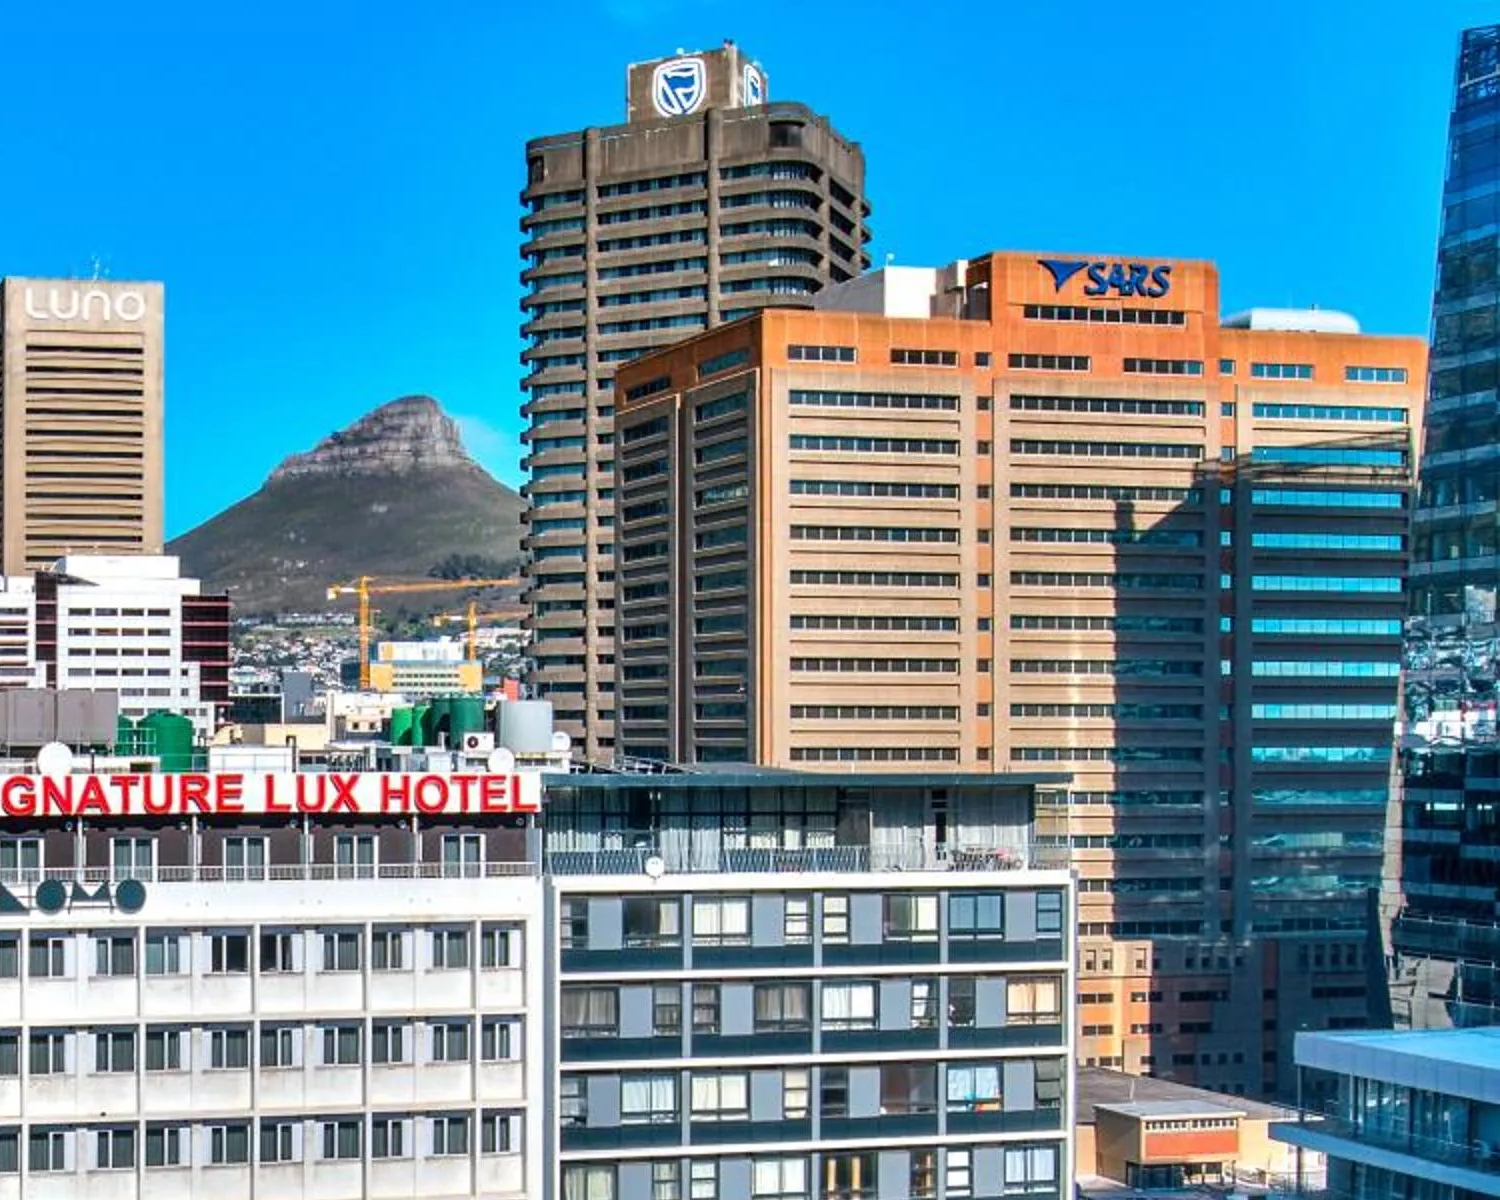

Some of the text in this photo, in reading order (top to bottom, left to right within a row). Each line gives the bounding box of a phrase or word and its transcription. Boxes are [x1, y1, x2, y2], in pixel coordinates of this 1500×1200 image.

[1084, 261, 1172, 297] SARS
[264, 773, 361, 814] LUX
[380, 773, 538, 815] HOTEL
